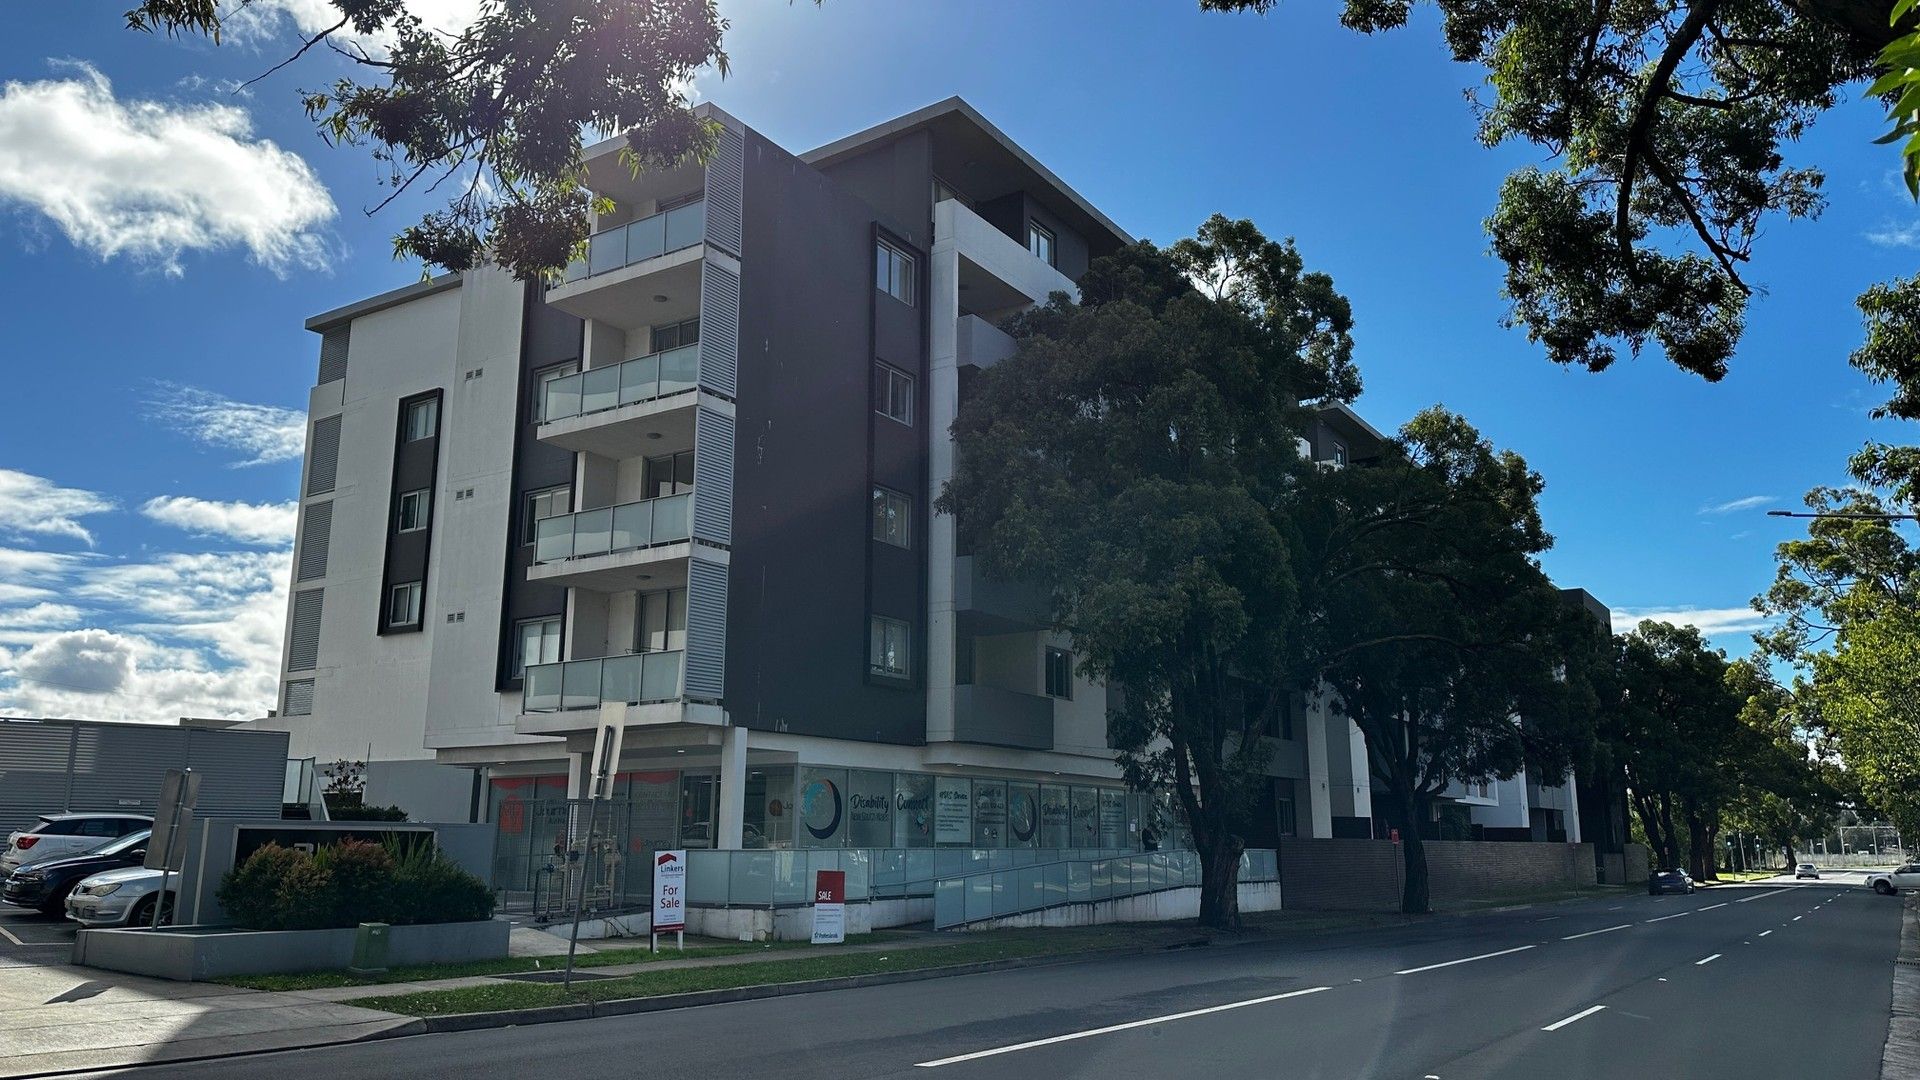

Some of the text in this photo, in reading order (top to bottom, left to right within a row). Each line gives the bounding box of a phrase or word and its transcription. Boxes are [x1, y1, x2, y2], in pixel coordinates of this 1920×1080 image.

[850, 794, 889, 814] Disability
[660, 864, 684, 873] Linkers
[663, 884, 678, 896] For
[818, 891, 832, 901] SALE
[660, 897, 680, 909] Sale
